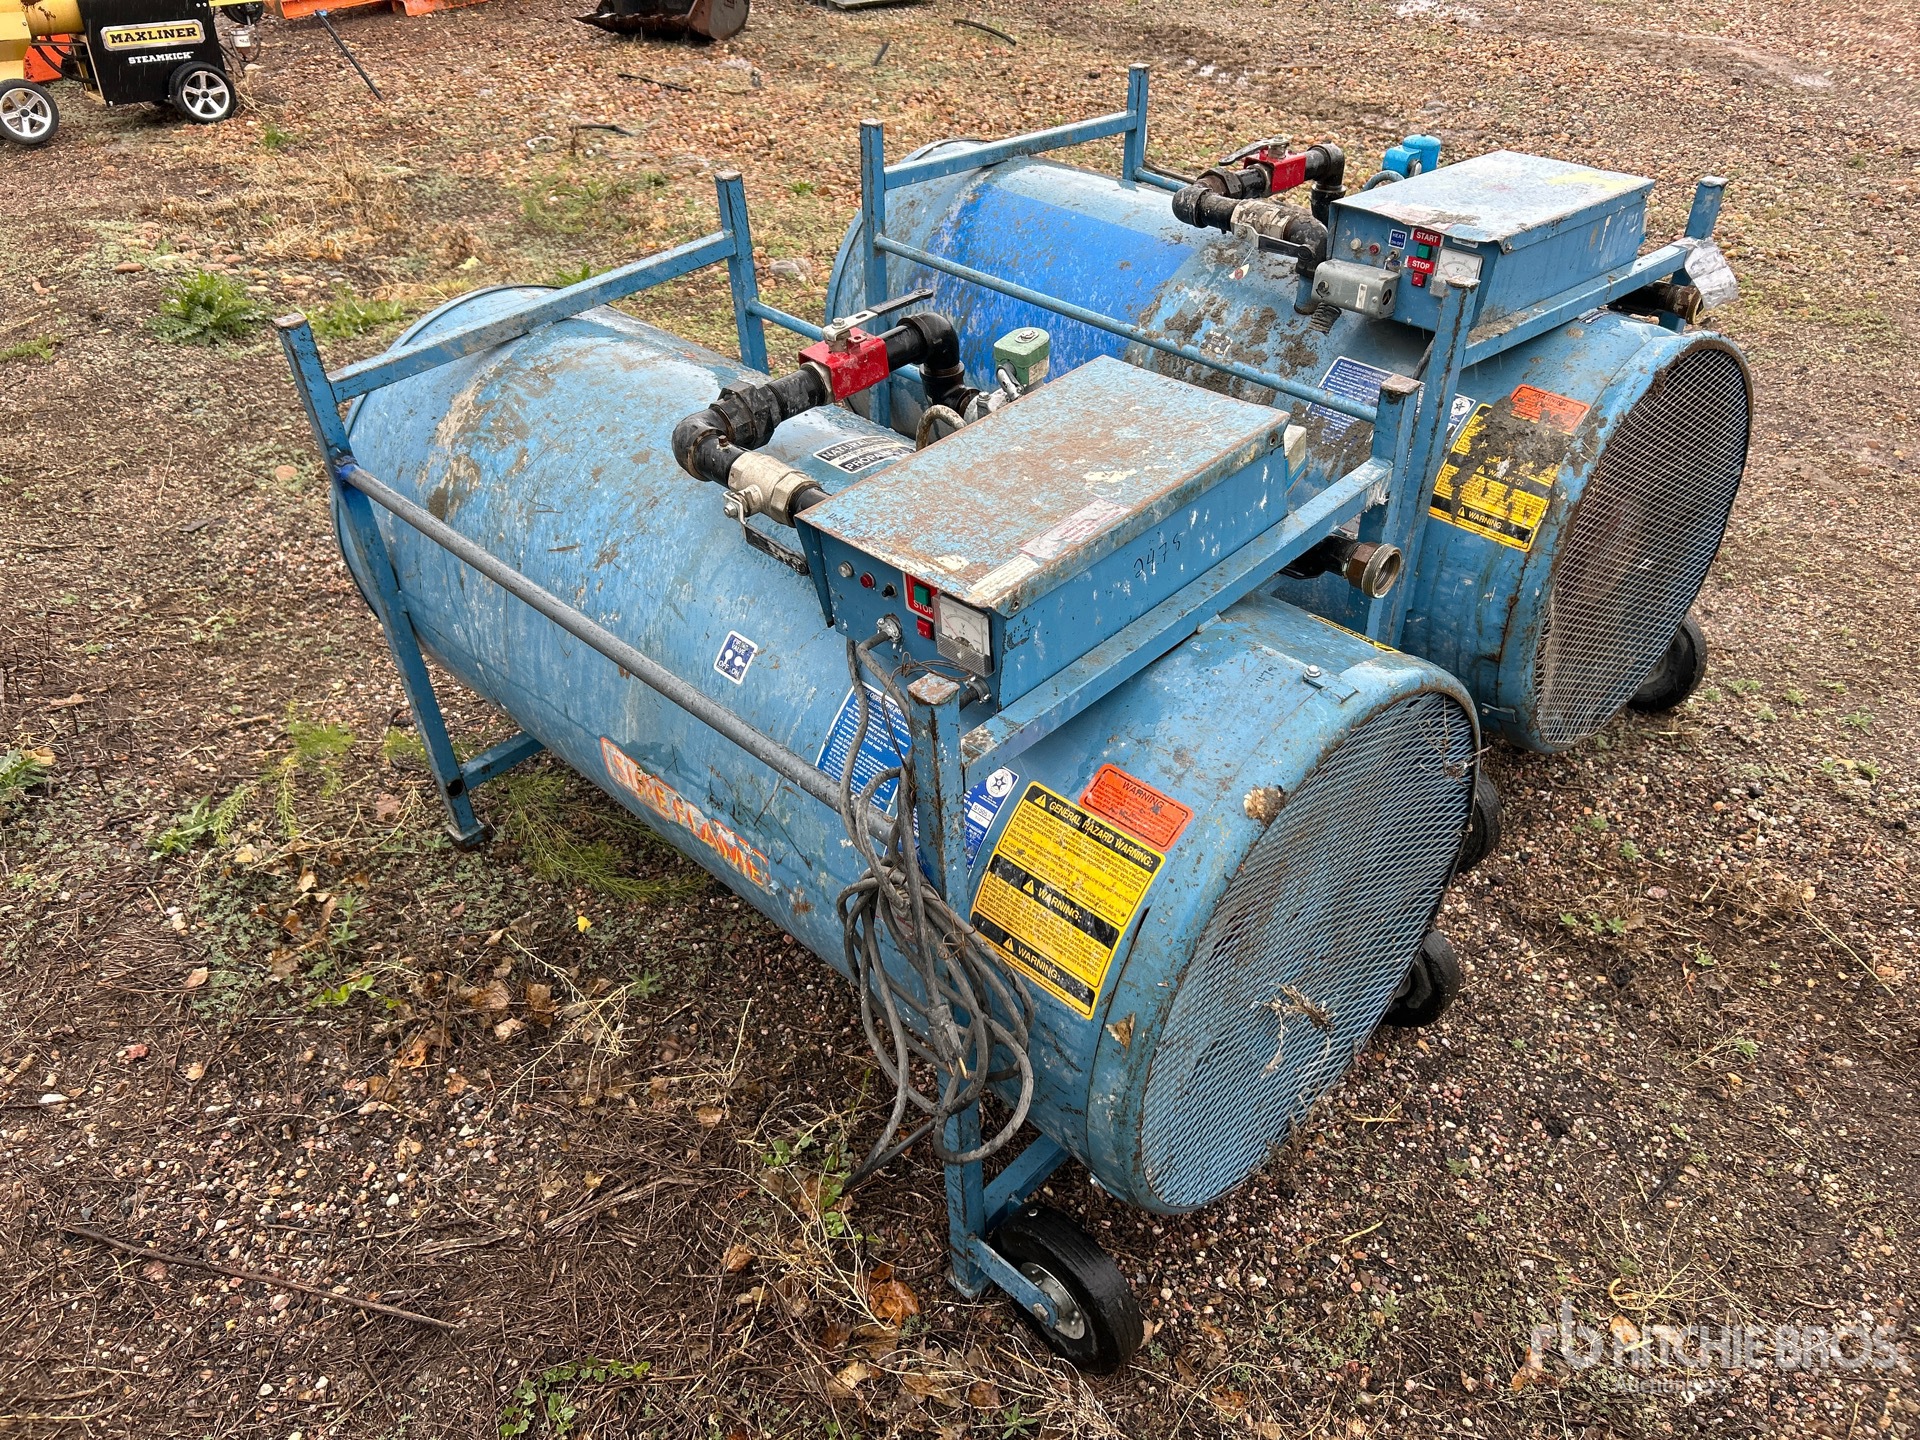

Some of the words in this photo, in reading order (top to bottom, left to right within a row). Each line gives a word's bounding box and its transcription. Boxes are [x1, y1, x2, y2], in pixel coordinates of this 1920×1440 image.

[110, 27, 197, 44] MAXLINER
[1392, 232, 1405, 240] HEAT
[1416, 231, 1438, 243] START
[1412, 260, 1430, 270] STOP
[913, 599, 933, 615] STOP
[732, 644, 746, 655] VALVE
[718, 660, 729, 670] OFF
[731, 668, 740, 676] ON
[1124, 781, 1165, 809] WARNING
[1049, 800, 1081, 825] GENERAL
[1083, 820, 1113, 844] HAZARD
[1116, 838, 1153, 867] WARNING:
[672, 799, 764, 886] FLAME
[1038, 888, 1082, 921] WARNING:
[1018, 946, 1061, 981] WARNING:
